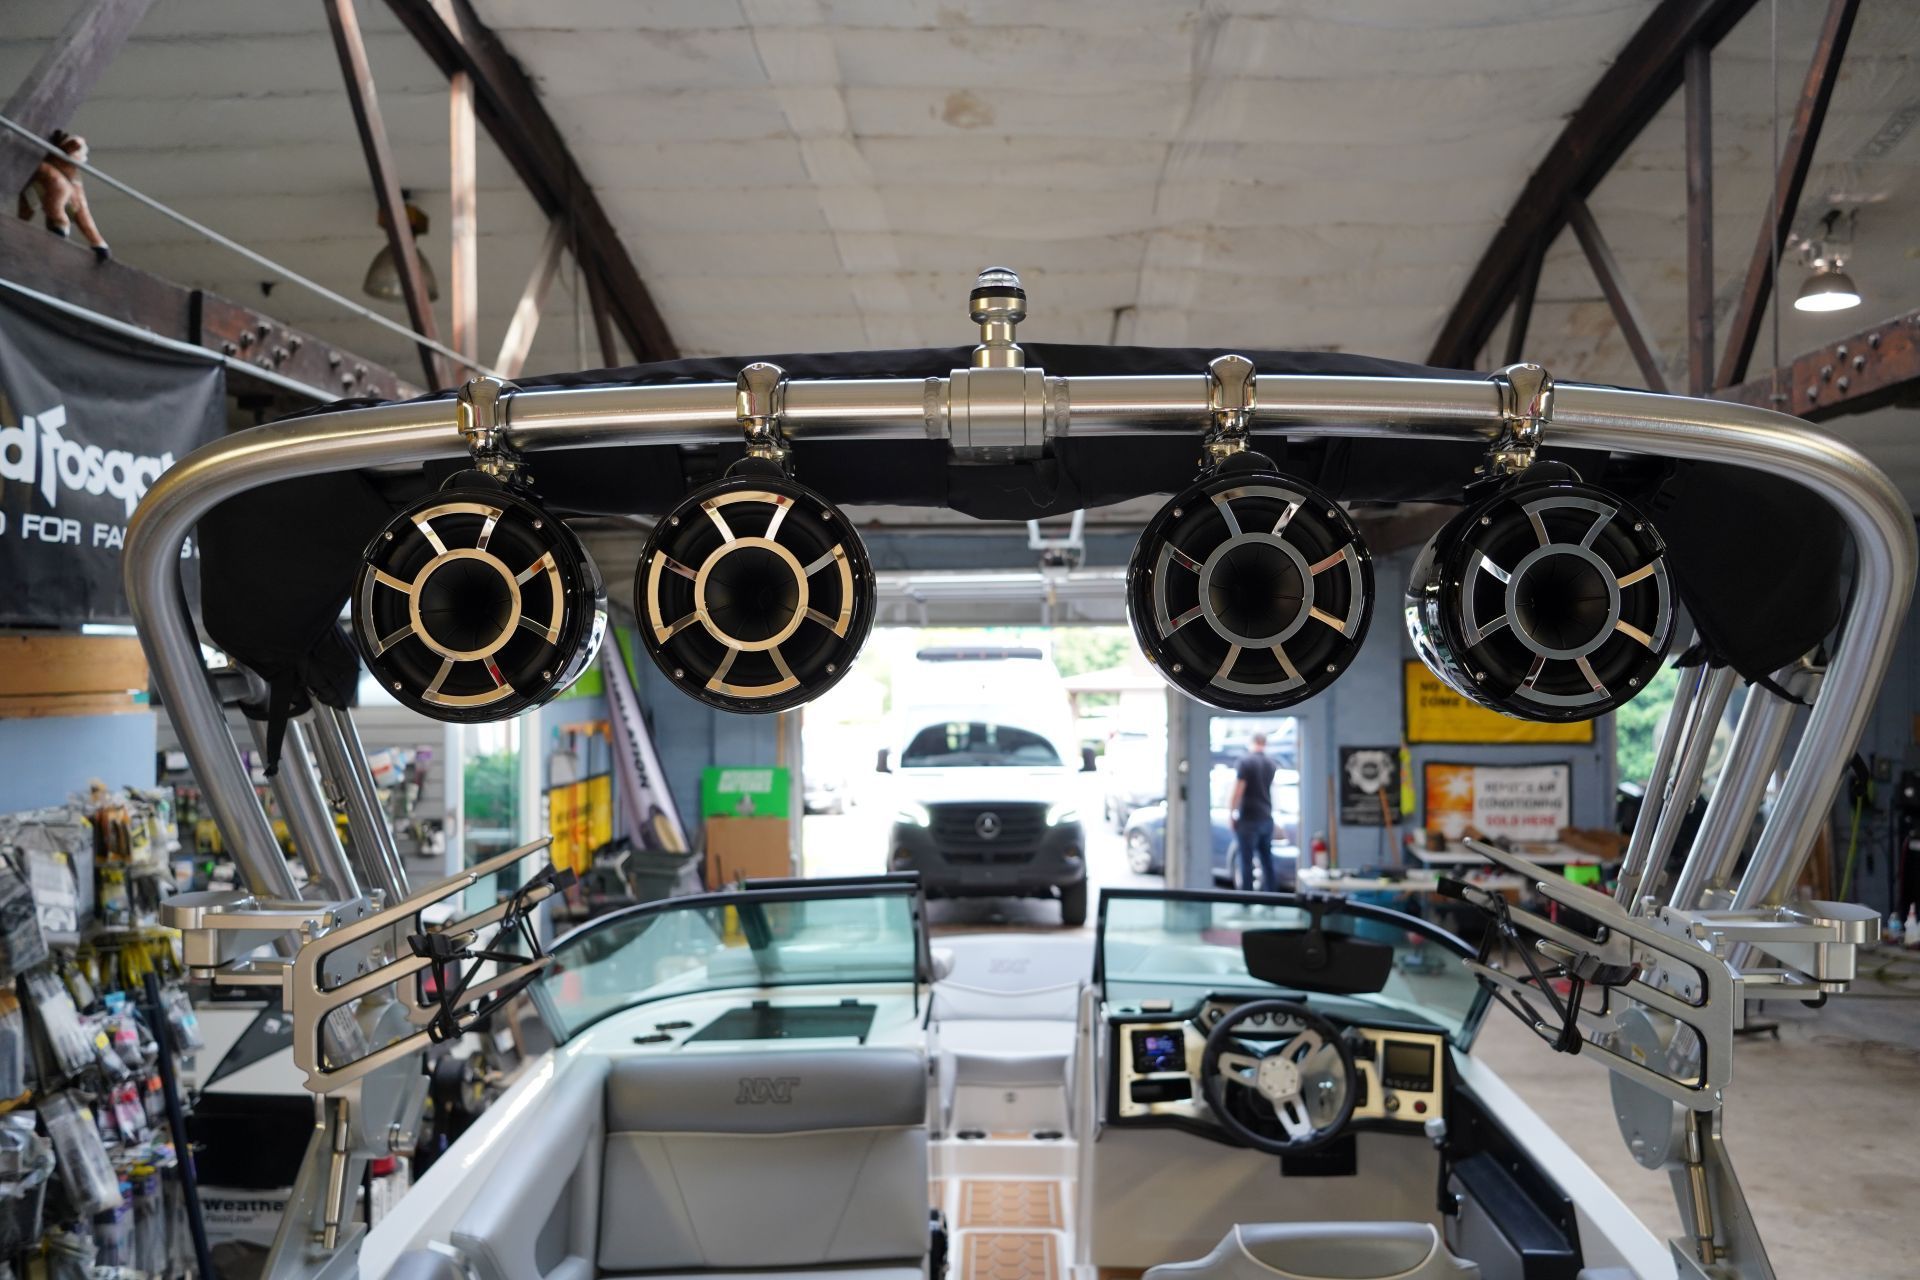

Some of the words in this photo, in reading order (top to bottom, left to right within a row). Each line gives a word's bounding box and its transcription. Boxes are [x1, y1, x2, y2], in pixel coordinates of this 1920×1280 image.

[22, 514, 82, 545] FOR
[734, 1076, 801, 1105] NXT
[203, 1199, 286, 1212] Weathe
